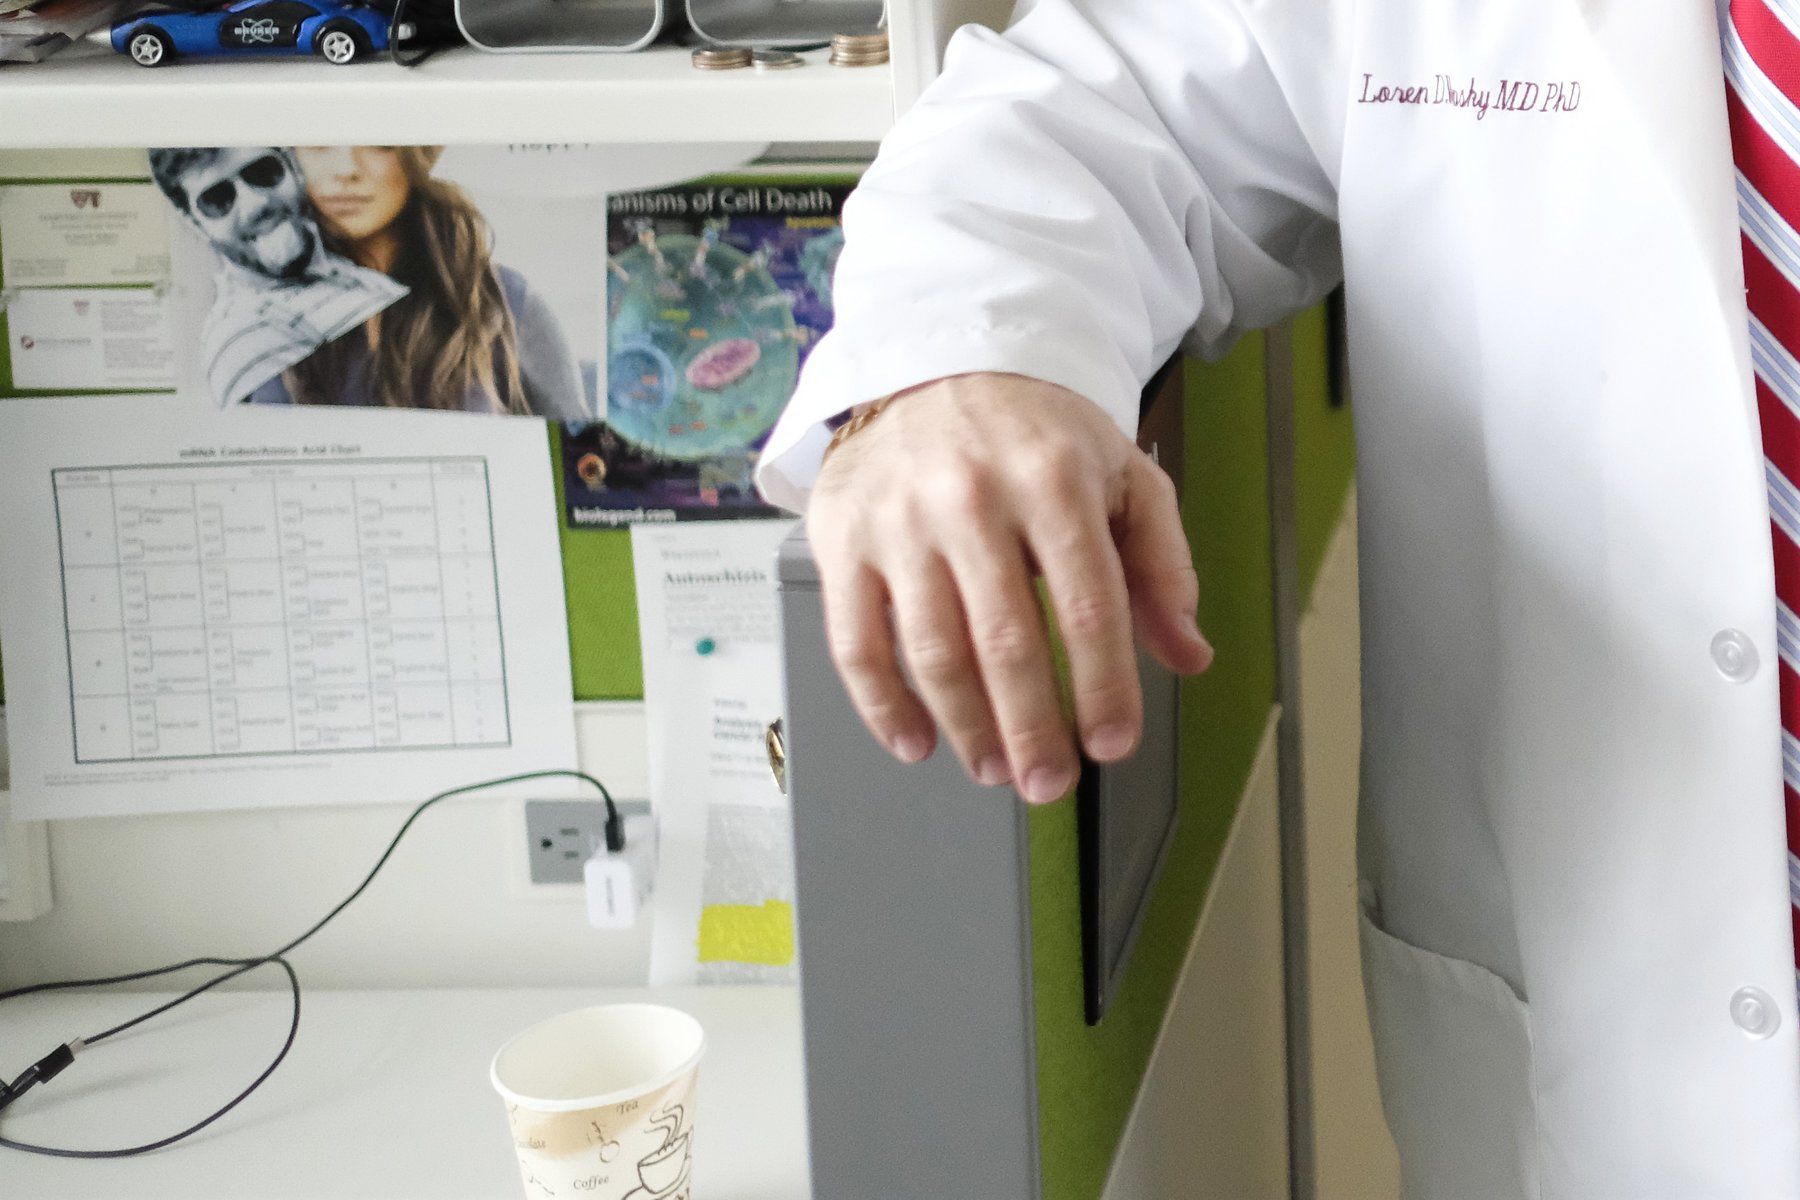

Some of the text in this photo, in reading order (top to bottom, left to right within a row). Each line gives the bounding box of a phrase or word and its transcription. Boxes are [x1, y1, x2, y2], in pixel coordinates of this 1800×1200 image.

[1357, 73, 1429, 105] Loren
[1492, 79, 1539, 112] MD
[1539, 81, 1581, 112] PhD
[693, 187, 714, 213] of
[720, 187, 760, 212] Cell
[766, 187, 833, 212] Death
[616, 1100, 639, 1114] Tea
[573, 1175, 610, 1191] Coffee
